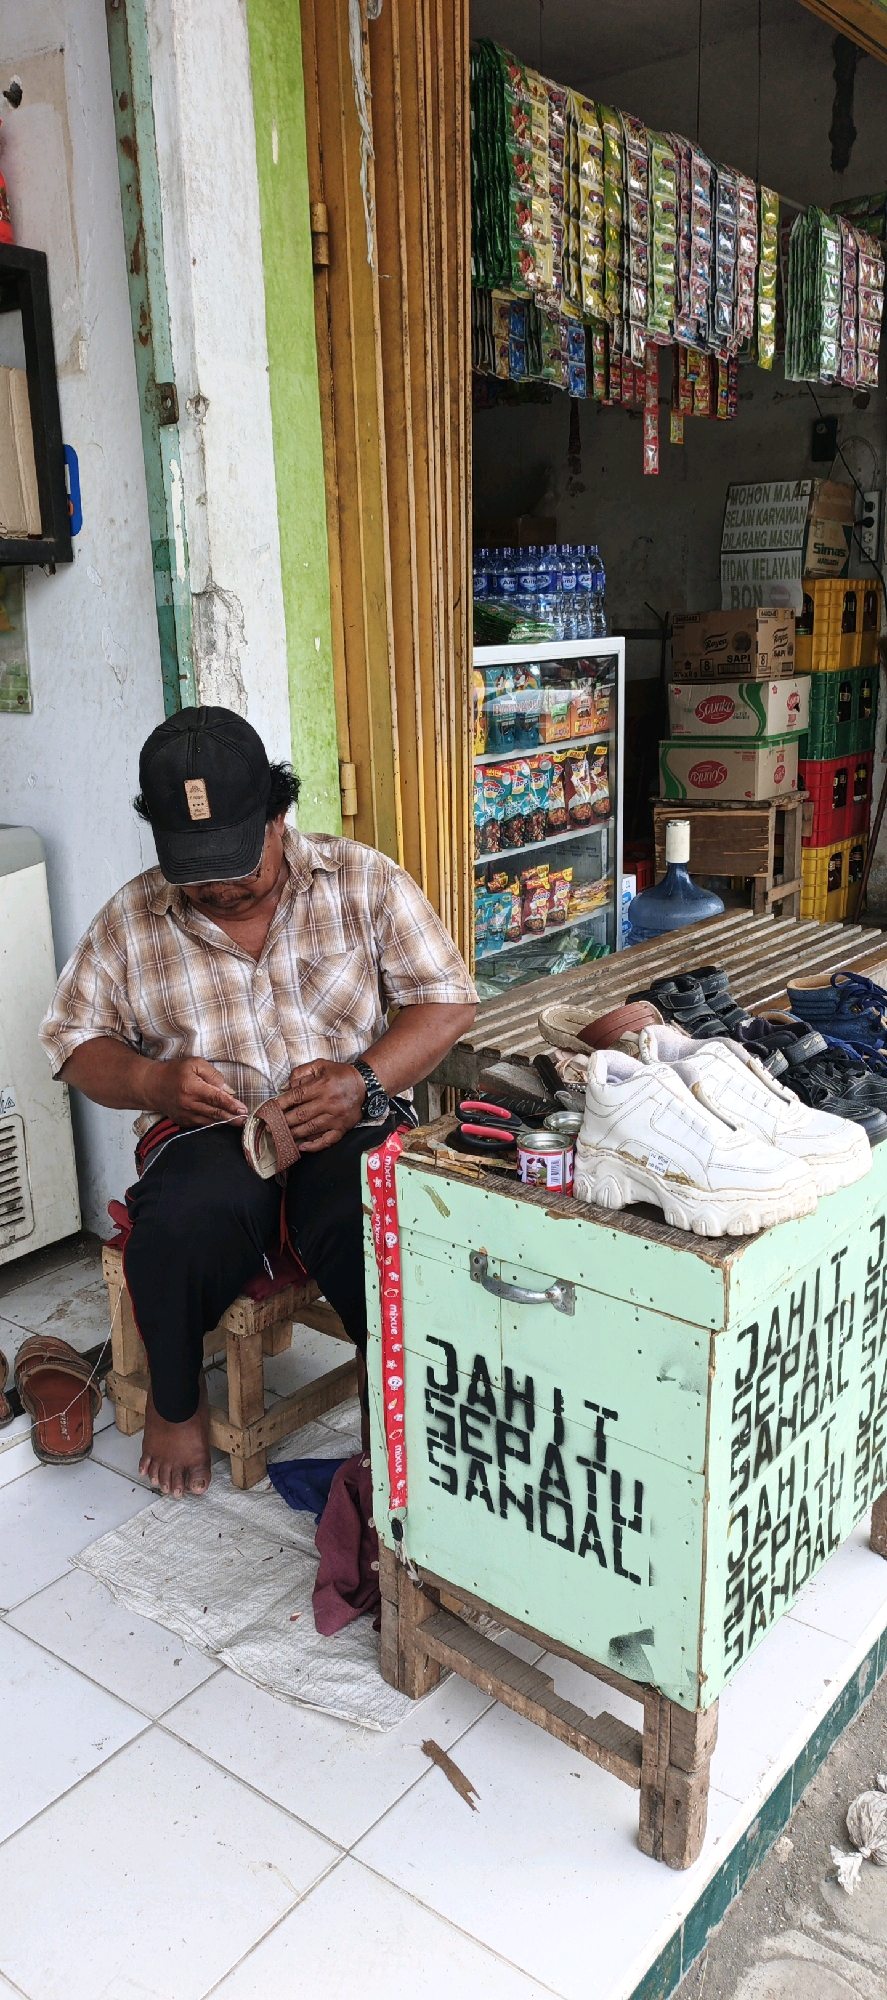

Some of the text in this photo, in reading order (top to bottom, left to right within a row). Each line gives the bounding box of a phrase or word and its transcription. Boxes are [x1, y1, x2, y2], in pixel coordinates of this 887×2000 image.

[729, 485, 771, 506] MOHON
[725, 506, 807, 528] SELAIN KARYAWAN
[723, 528, 803, 550] DILARANG MASUK
[813, 542, 847, 557] Simas
[722, 557, 801, 581] TIDAK MELAYANI
[730, 585, 764, 610] BON
[704, 660, 710, 671] 8
[727, 655, 751, 663] SAPI
[761, 655, 766, 665] 8
[384, 1155, 392, 1188] mixue
[390, 1304, 398, 1335] mixue
[735, 1246, 848, 1391] JAHIT
[731, 1292, 854, 1437] SEPATU
[426, 1334, 618, 1462] JAHIT
[730, 1349, 849, 1504] SANDAL
[394, 1444, 403, 1473] mixue
[425, 1388, 642, 1533] SEPATU
[728, 1412, 836, 1572] JAHIT
[427, 1437, 641, 1585] SANDAL
[725, 1451, 844, 1621] SEPATU
[724, 1508, 840, 1679] SANDAL
